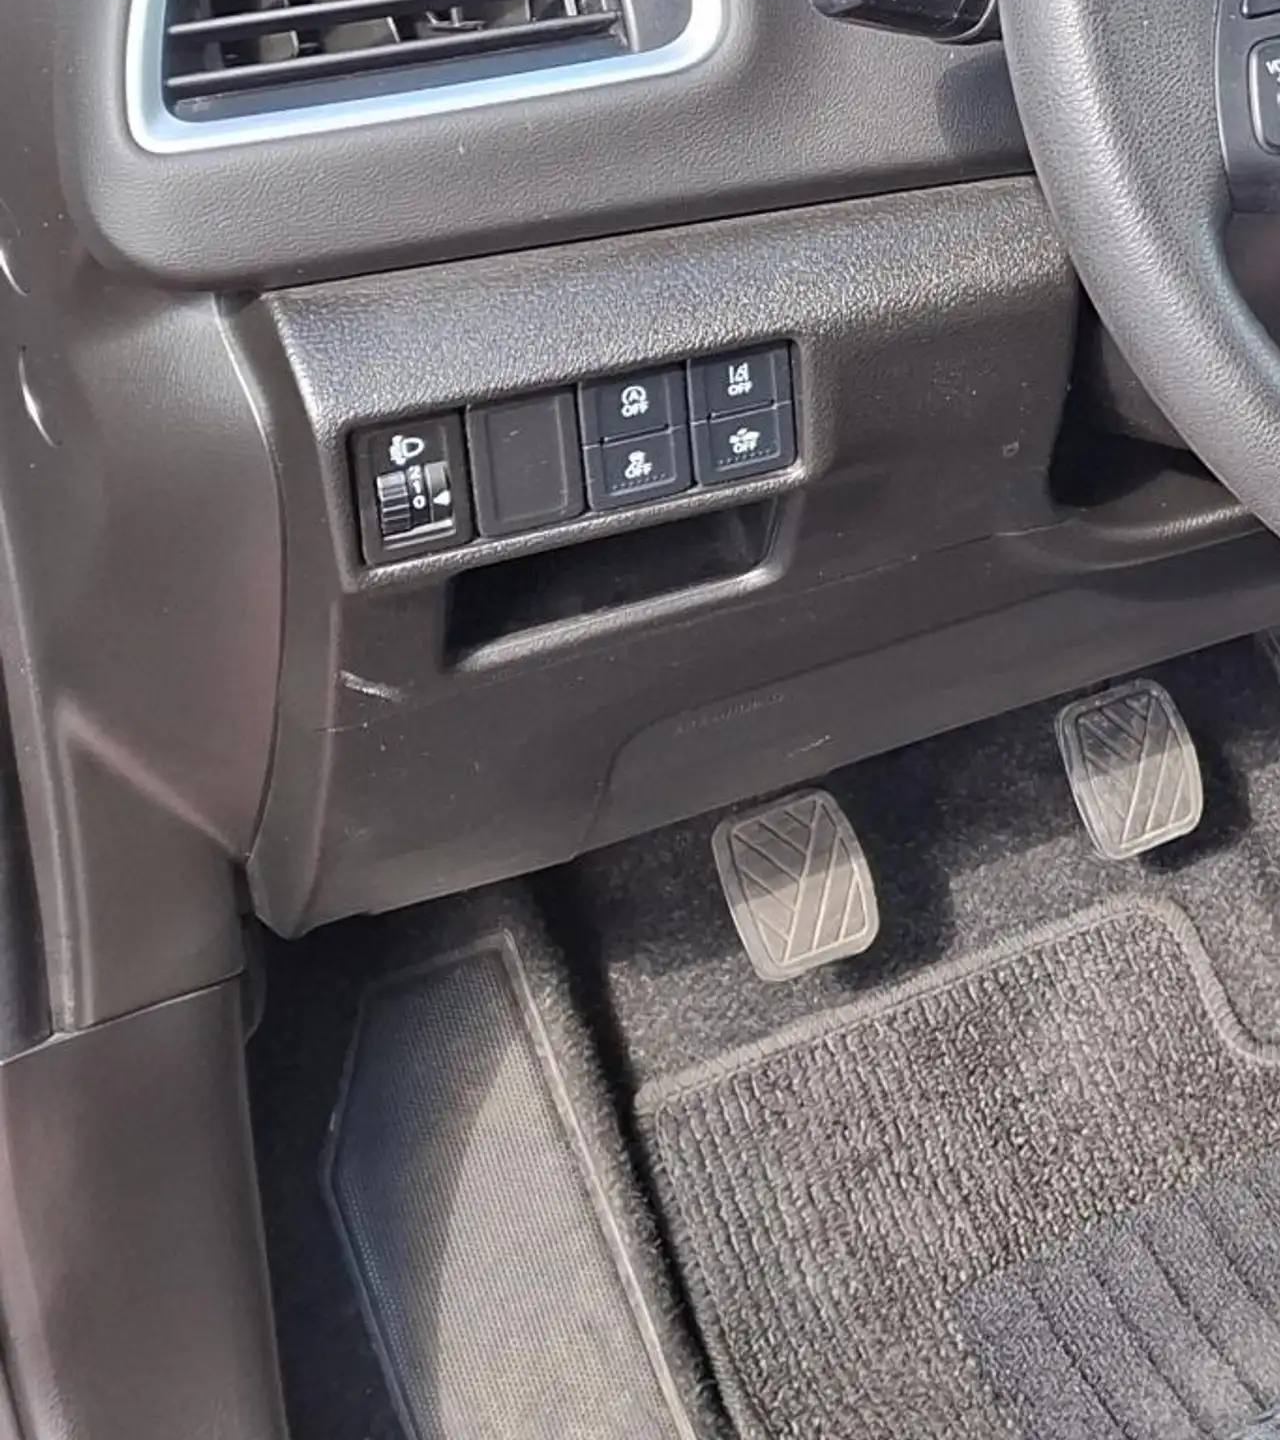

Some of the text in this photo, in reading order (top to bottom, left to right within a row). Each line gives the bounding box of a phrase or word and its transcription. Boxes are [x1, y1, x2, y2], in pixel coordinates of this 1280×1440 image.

[728, 380, 753, 396] OFF
[621, 401, 649, 418] OFF
[732, 439, 758, 454] OFF
[408, 465, 421, 480] 2
[624, 461, 652, 479] OFF
[412, 479, 421, 494] 1
[412, 495, 426, 510] 0
